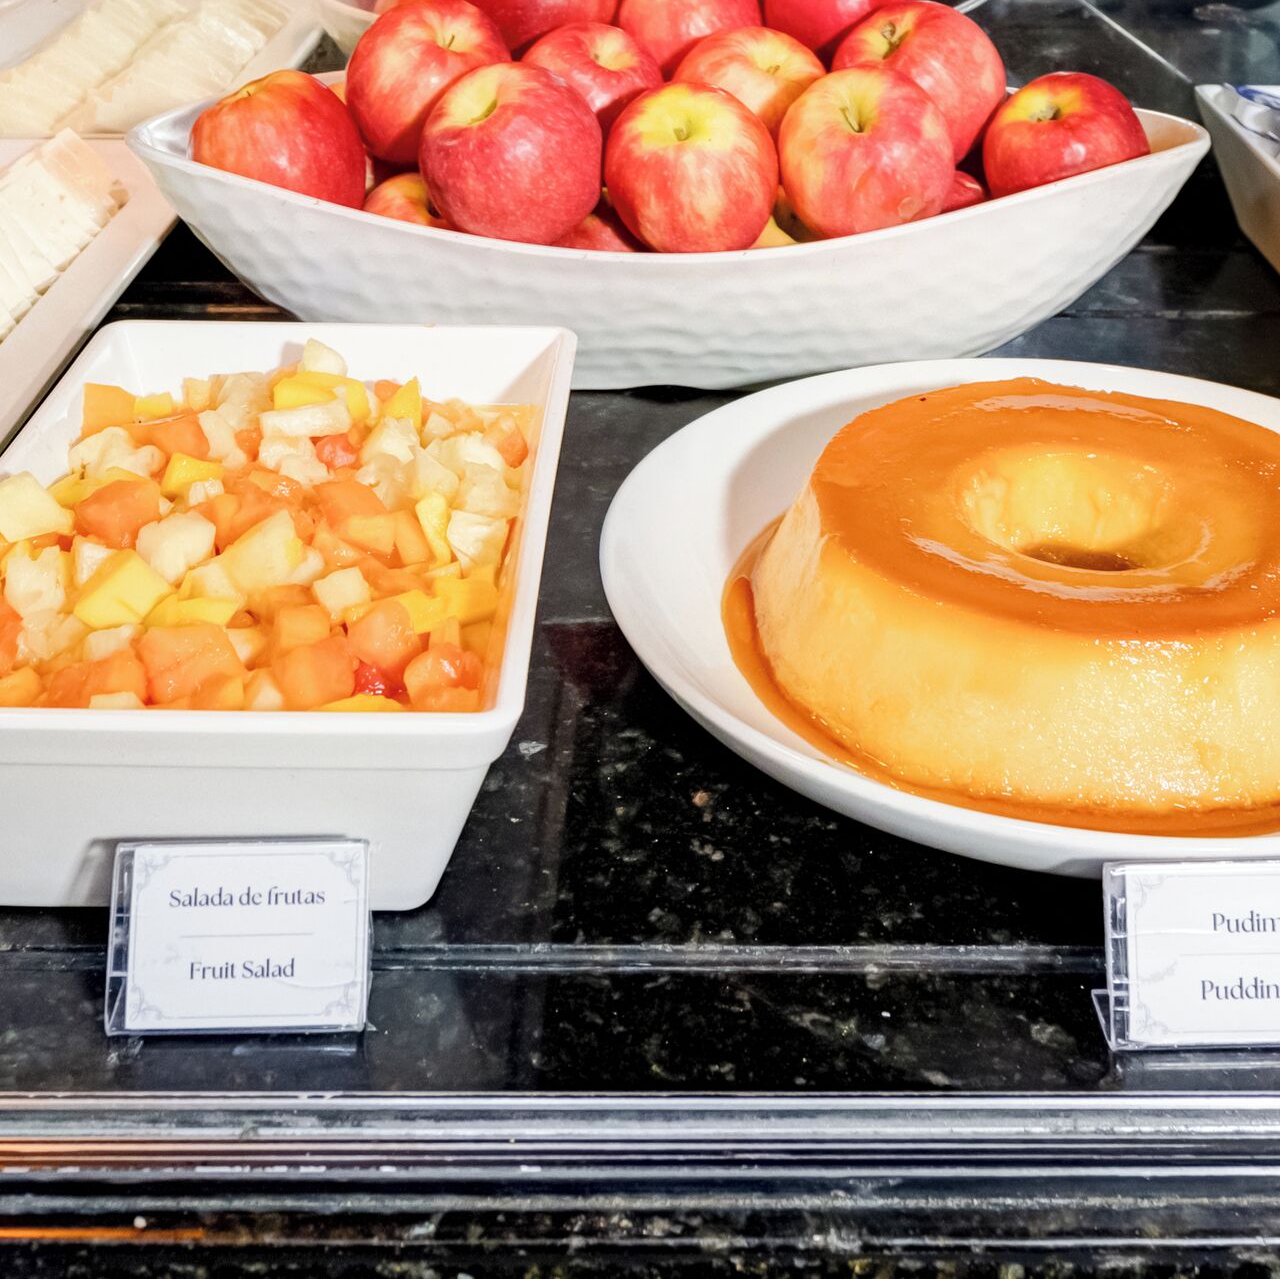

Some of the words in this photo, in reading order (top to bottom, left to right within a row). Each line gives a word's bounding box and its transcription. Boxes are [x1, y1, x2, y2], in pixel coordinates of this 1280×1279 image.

[169, 886, 234, 908] Salada
[238, 886, 263, 906] de
[267, 885, 326, 906] frutas
[189, 960, 237, 980] Fruit
[241, 957, 296, 979] Salad
